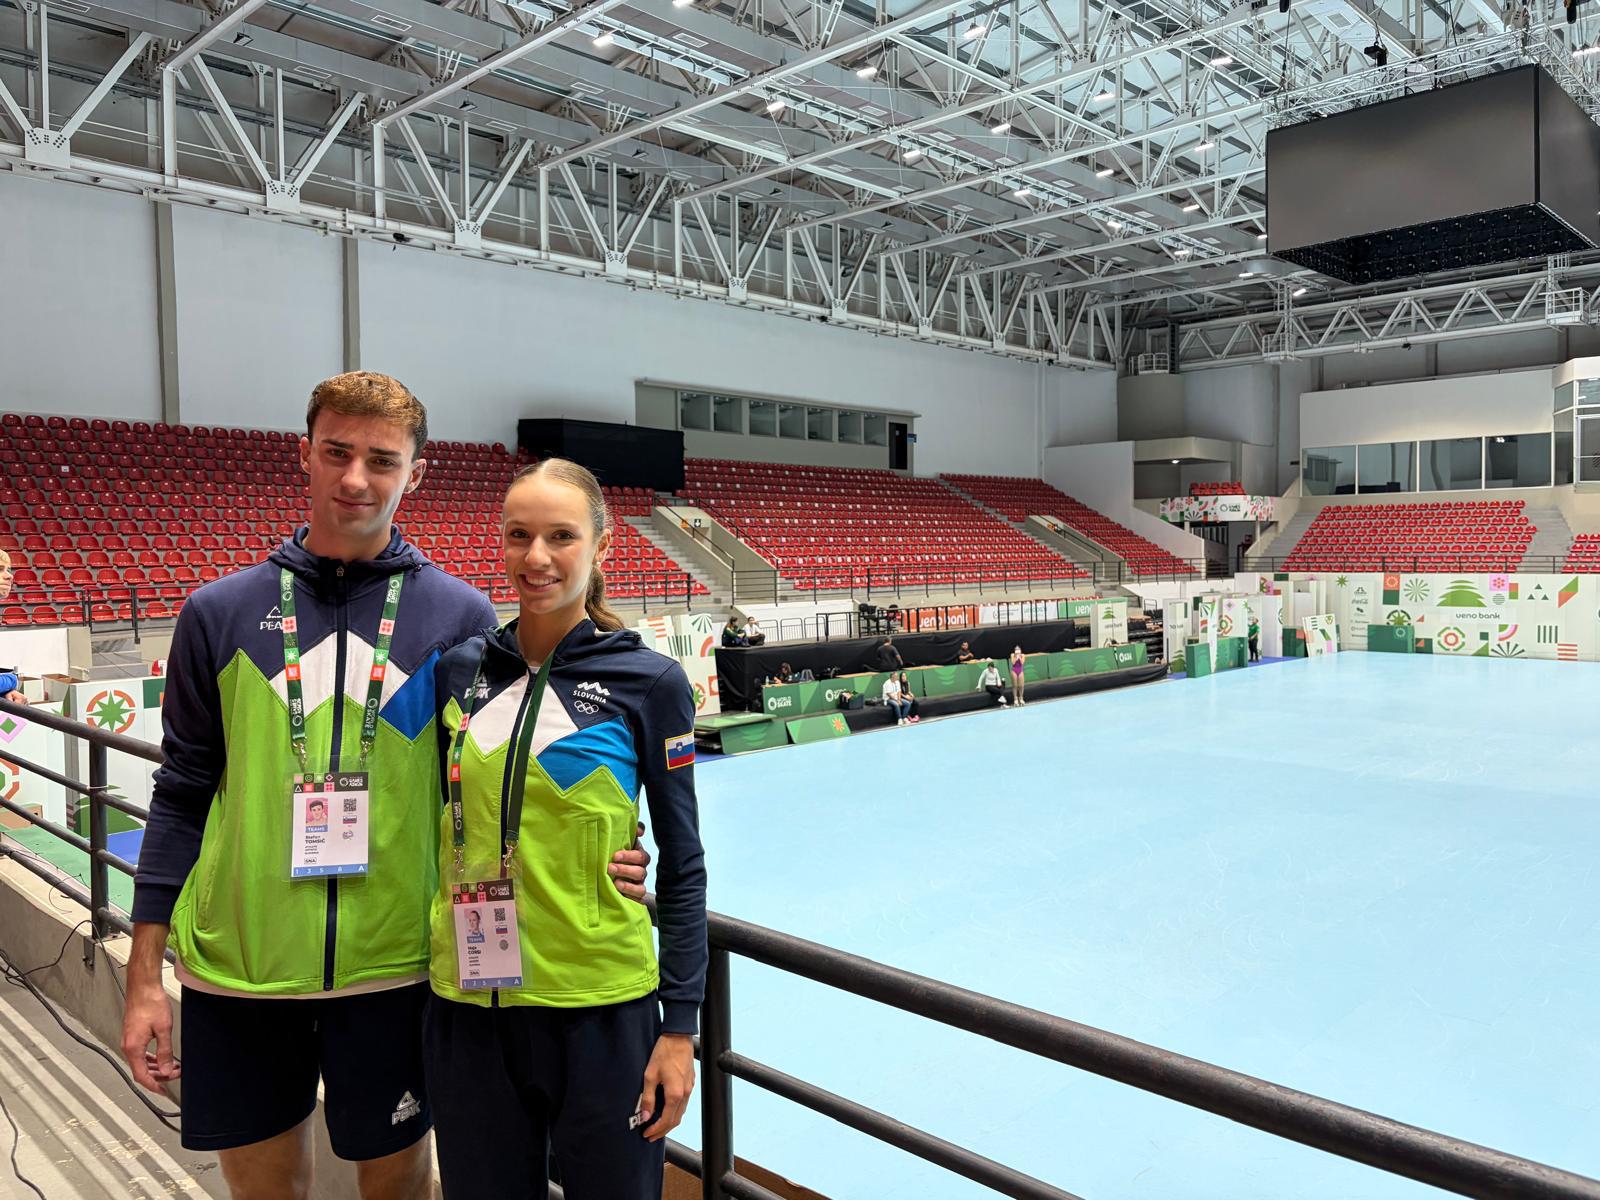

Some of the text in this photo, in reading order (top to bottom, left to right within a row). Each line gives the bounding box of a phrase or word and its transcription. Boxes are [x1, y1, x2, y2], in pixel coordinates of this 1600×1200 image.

[259, 621, 283, 631] PEA
[573, 690, 607, 704] SLOVENIA
[391, 1100, 421, 1126] PEAK
